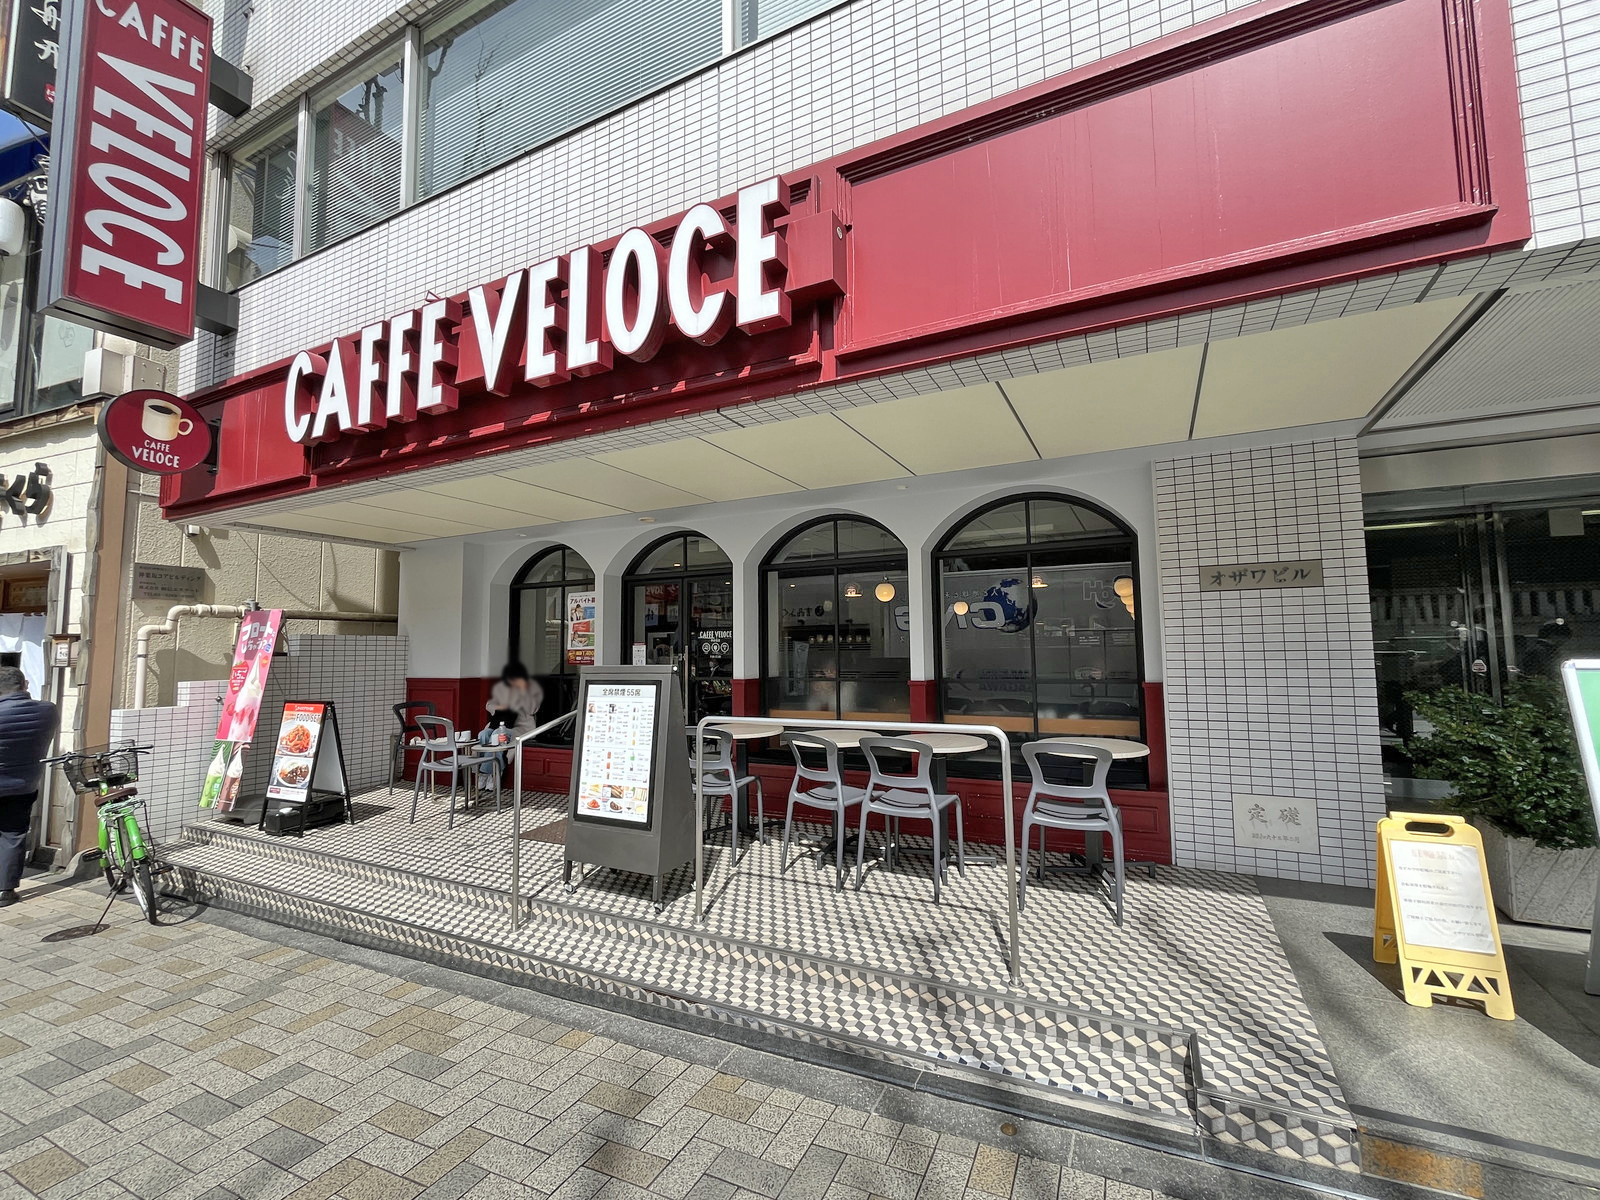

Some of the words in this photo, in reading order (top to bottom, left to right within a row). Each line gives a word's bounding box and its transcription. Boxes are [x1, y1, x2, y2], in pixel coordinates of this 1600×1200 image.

[81, 52, 196, 304] VELOCE
[469, 178, 781, 391] VELOCE
[131, 445, 180, 468] VELOCE
[1209, 567, 1312, 587] オザワビル
